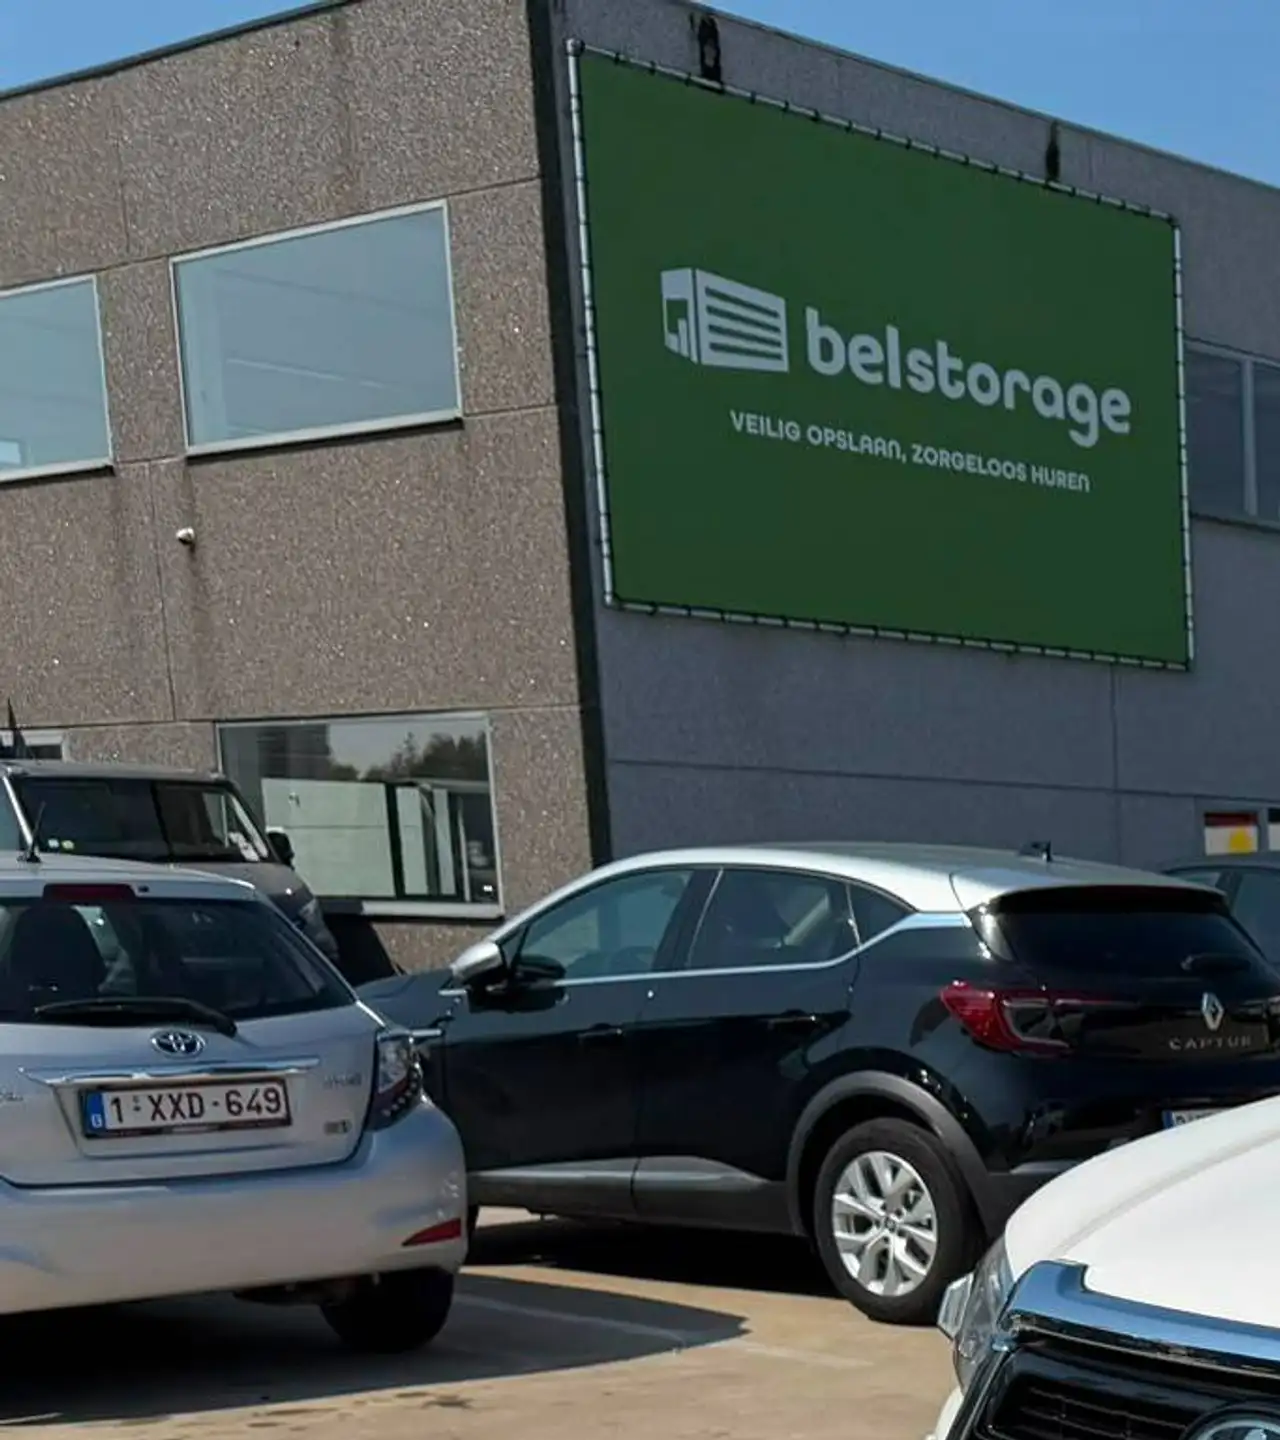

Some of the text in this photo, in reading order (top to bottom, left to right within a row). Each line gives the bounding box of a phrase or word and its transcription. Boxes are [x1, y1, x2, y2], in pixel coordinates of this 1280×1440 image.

[806, 306, 1131, 448] belstorage
[730, 409, 800, 442] VEILIG
[911, 443, 1027, 482] ZORGELOOS
[1031, 464, 1090, 493] HUREN
